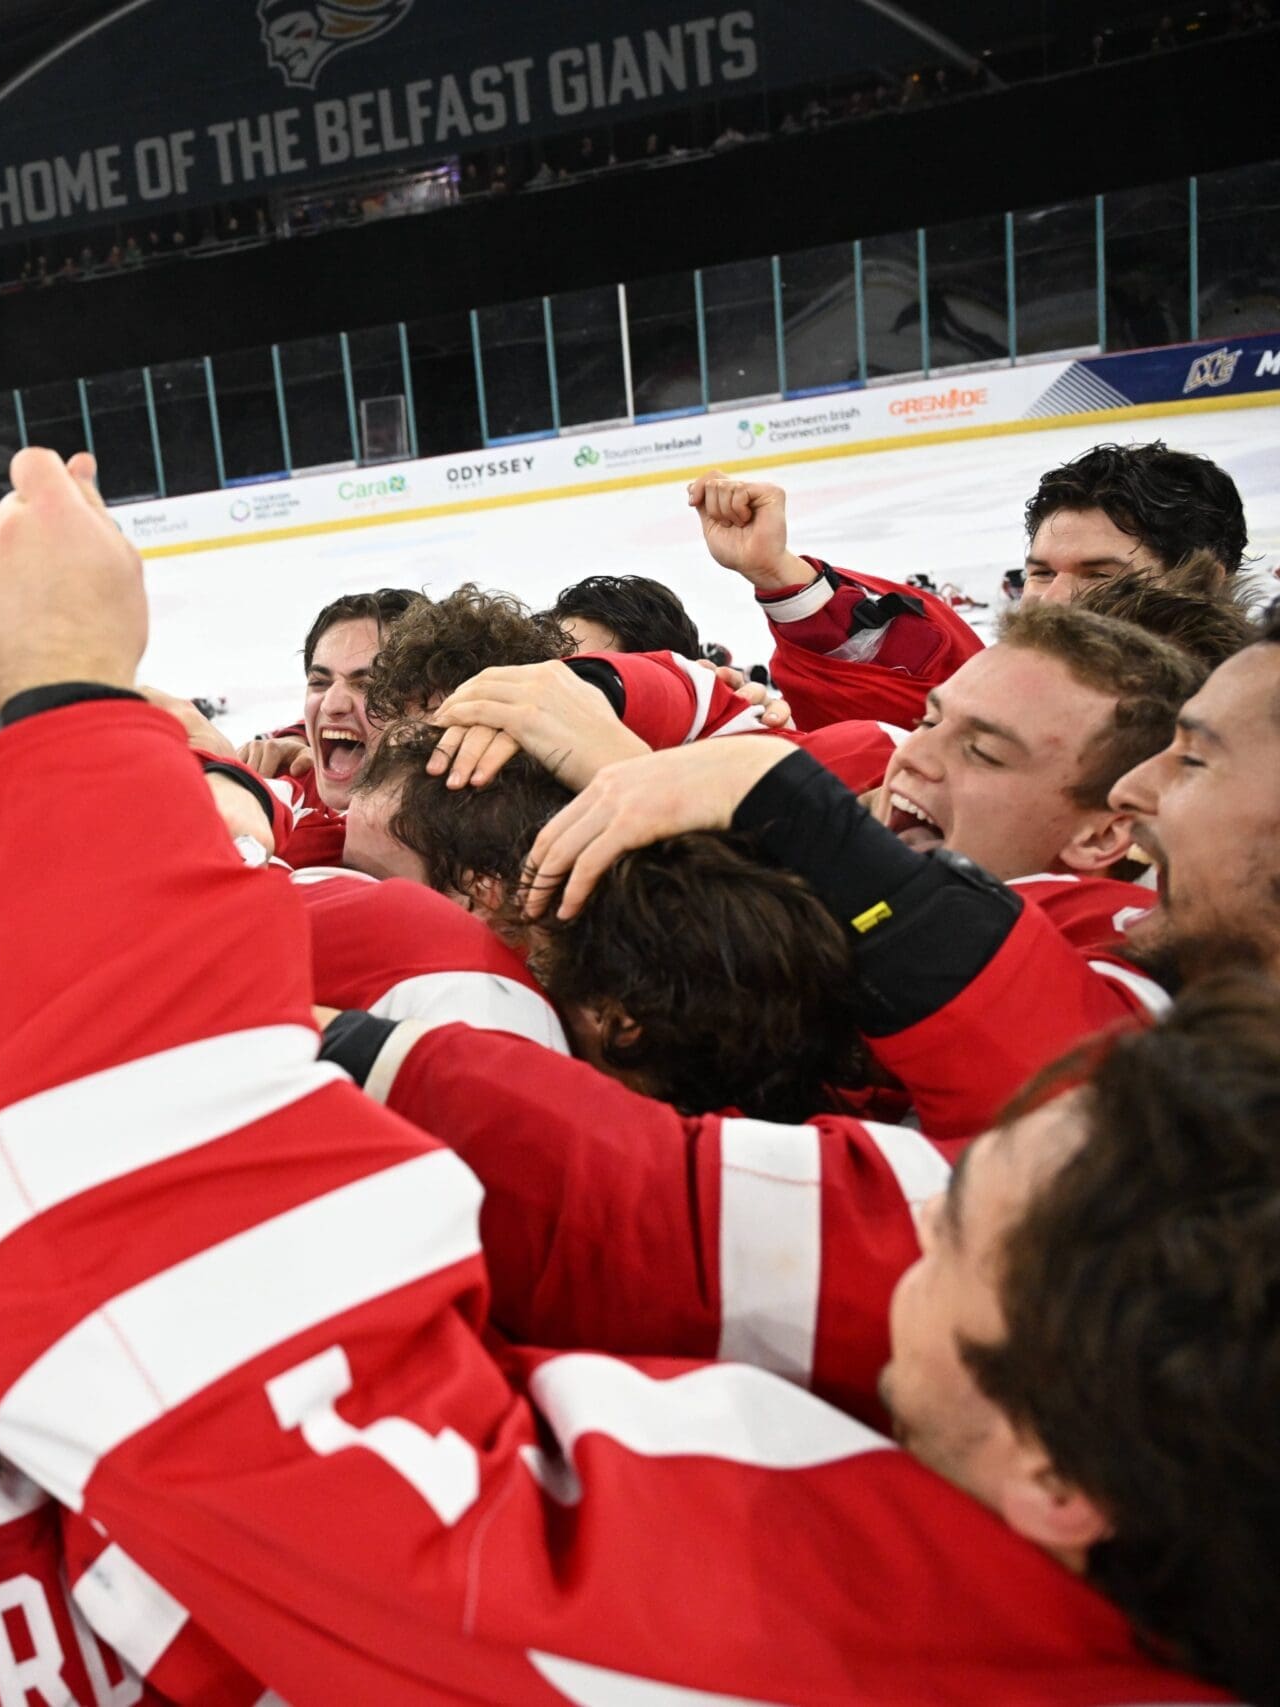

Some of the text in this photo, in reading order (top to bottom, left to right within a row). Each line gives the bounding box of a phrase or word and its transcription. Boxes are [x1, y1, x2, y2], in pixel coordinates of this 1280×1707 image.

[133, 130, 197, 201] OF
[207, 107, 308, 186] THE
[313, 57, 535, 167] BELFAST
[547, 10, 759, 118] GIANTS
[888, 387, 988, 416] GRENADE
[768, 405, 861, 429] Northern Irish
[769, 422, 851, 442] Connections
[602, 444, 652, 459] Tourism
[654, 433, 702, 452] Ireland
[446, 455, 535, 483] ODYSSEY
[338, 479, 388, 501] Cara
[133, 512, 166, 526] Belfast
